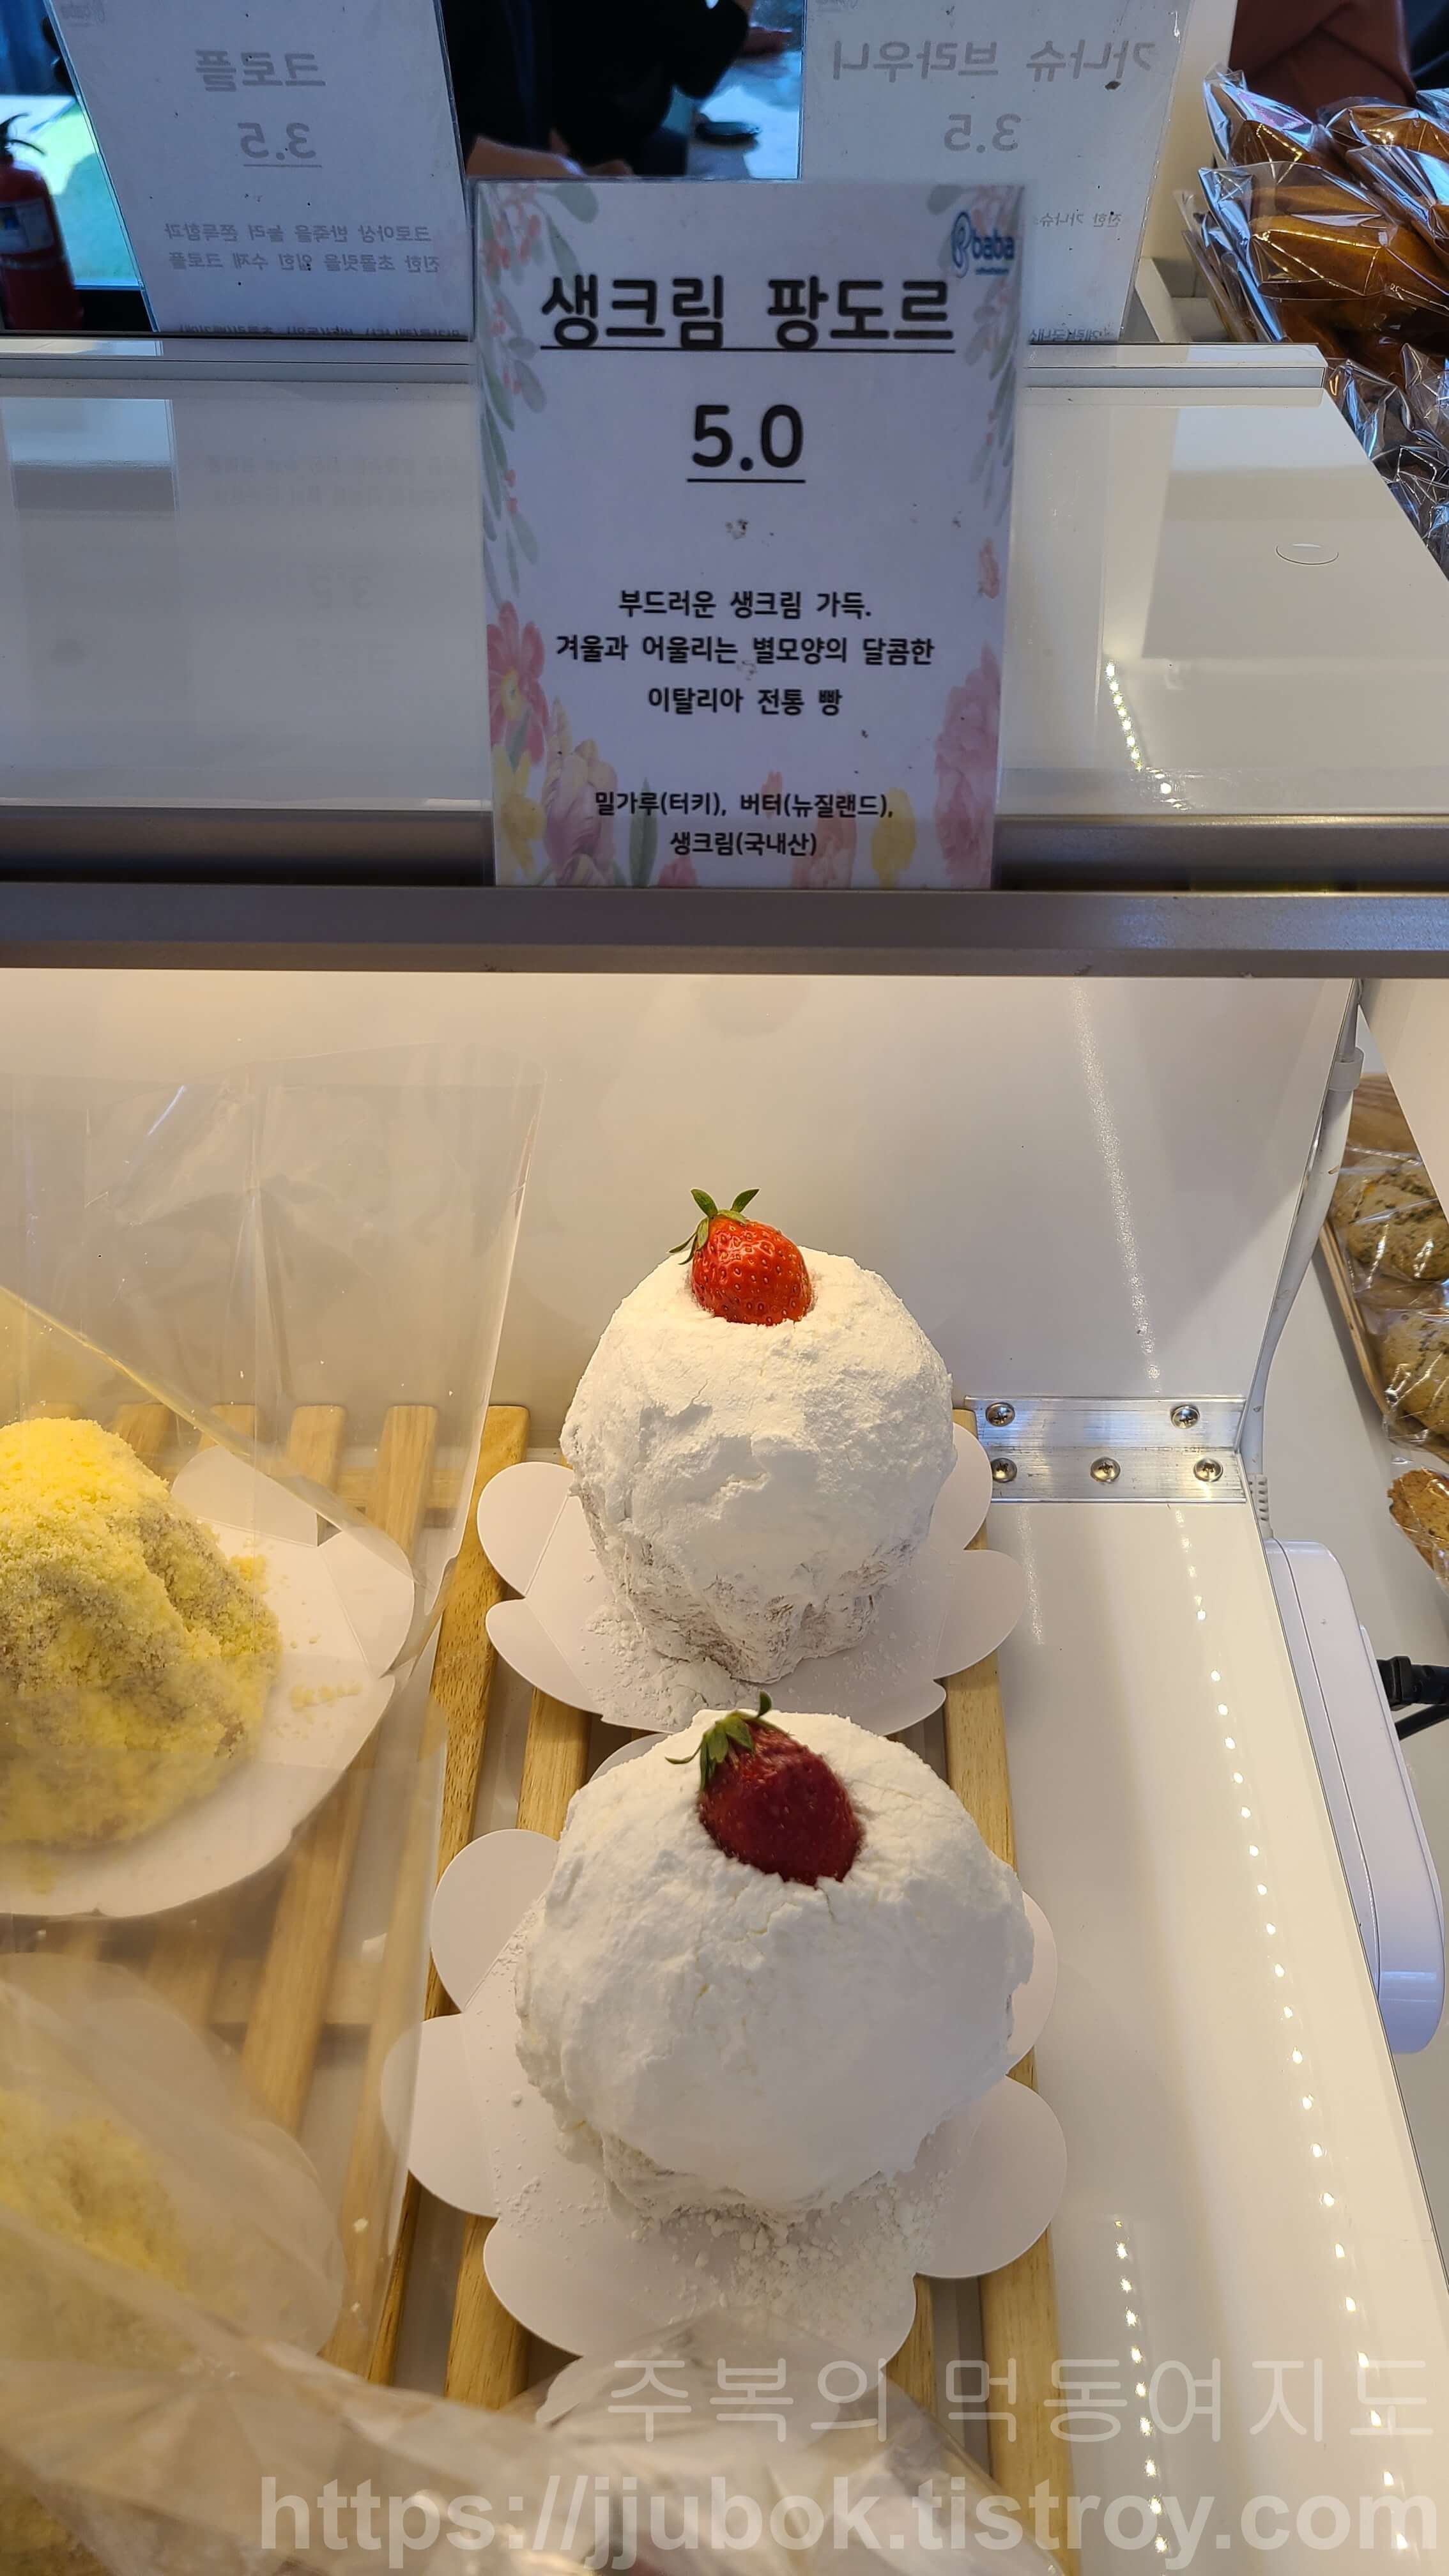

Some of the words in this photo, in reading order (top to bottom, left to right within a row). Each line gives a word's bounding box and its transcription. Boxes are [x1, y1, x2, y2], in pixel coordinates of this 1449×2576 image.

[540, 273, 724, 349] 생크림
[767, 275, 954, 351] 팡도르
[691, 404, 804, 471] 5.0
[618, 590, 717, 619] 부드러운
[730, 591, 802, 620] 생크림
[816, 591, 872, 620] 가득.
[556, 635, 628, 663] 겨울과
[642, 636, 739, 664] 어울리는
[753, 637, 848, 665] 별모양의
[862, 638, 935, 666] 달콤한
[648, 687, 744, 714] 이탈리아
[757, 689, 805, 716] 전통
[818, 689, 843, 716] 빵
[595, 792, 727, 817] 밀가루(터키),
[740, 792, 894, 818] 버터(뉴질랜드),
[670, 831, 817, 856] 생크림(국내산)
